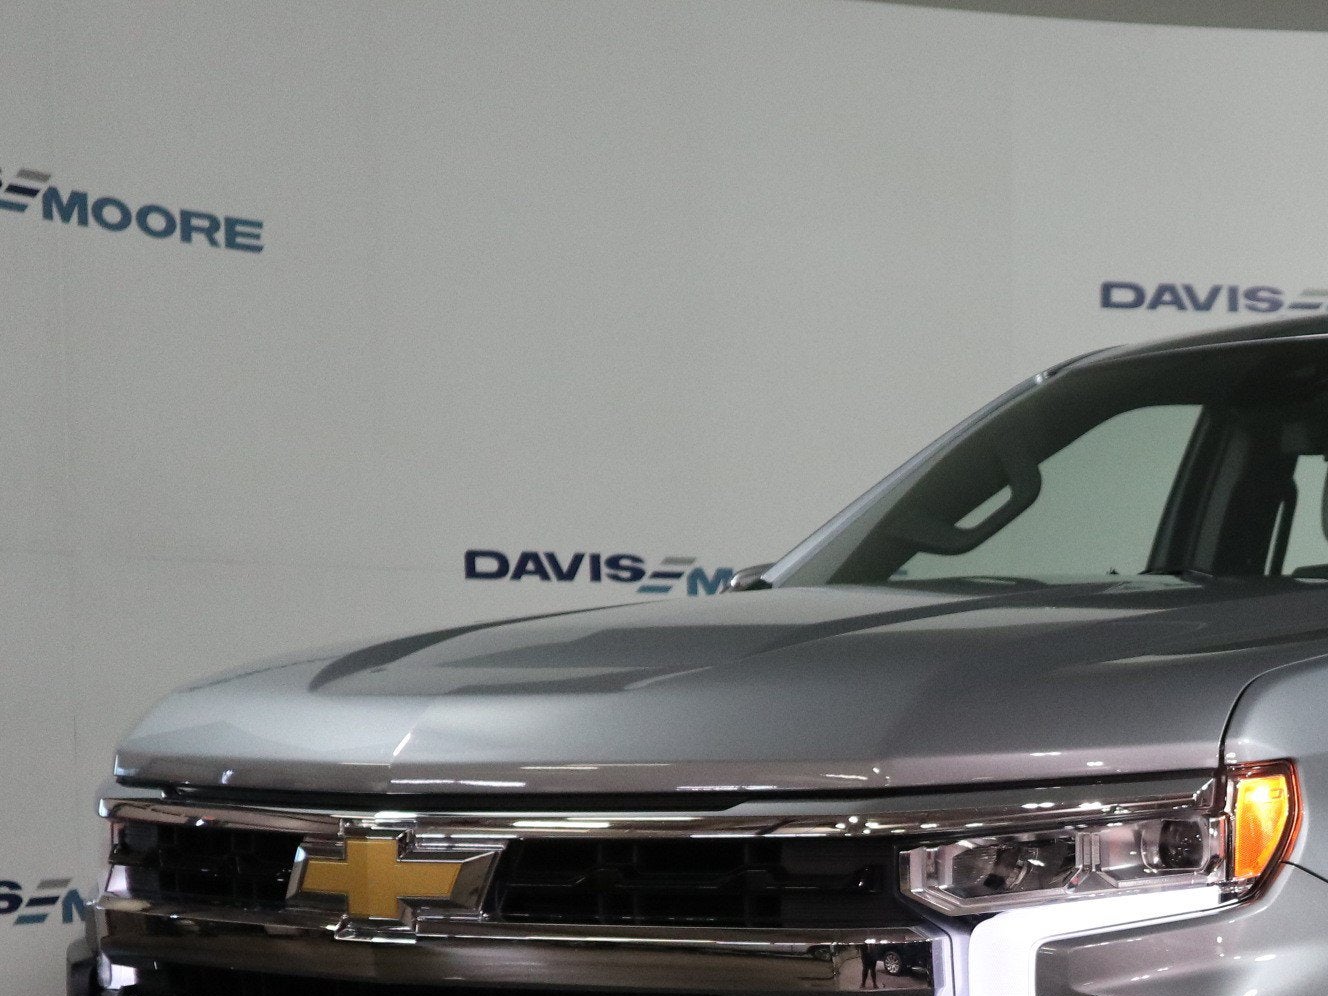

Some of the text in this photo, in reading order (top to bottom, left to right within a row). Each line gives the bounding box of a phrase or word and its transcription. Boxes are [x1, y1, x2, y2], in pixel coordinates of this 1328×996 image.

[42, 186, 264, 254] MOORE
[1100, 281, 1284, 313] DAVIS
[464, 549, 646, 582] DAVIS
